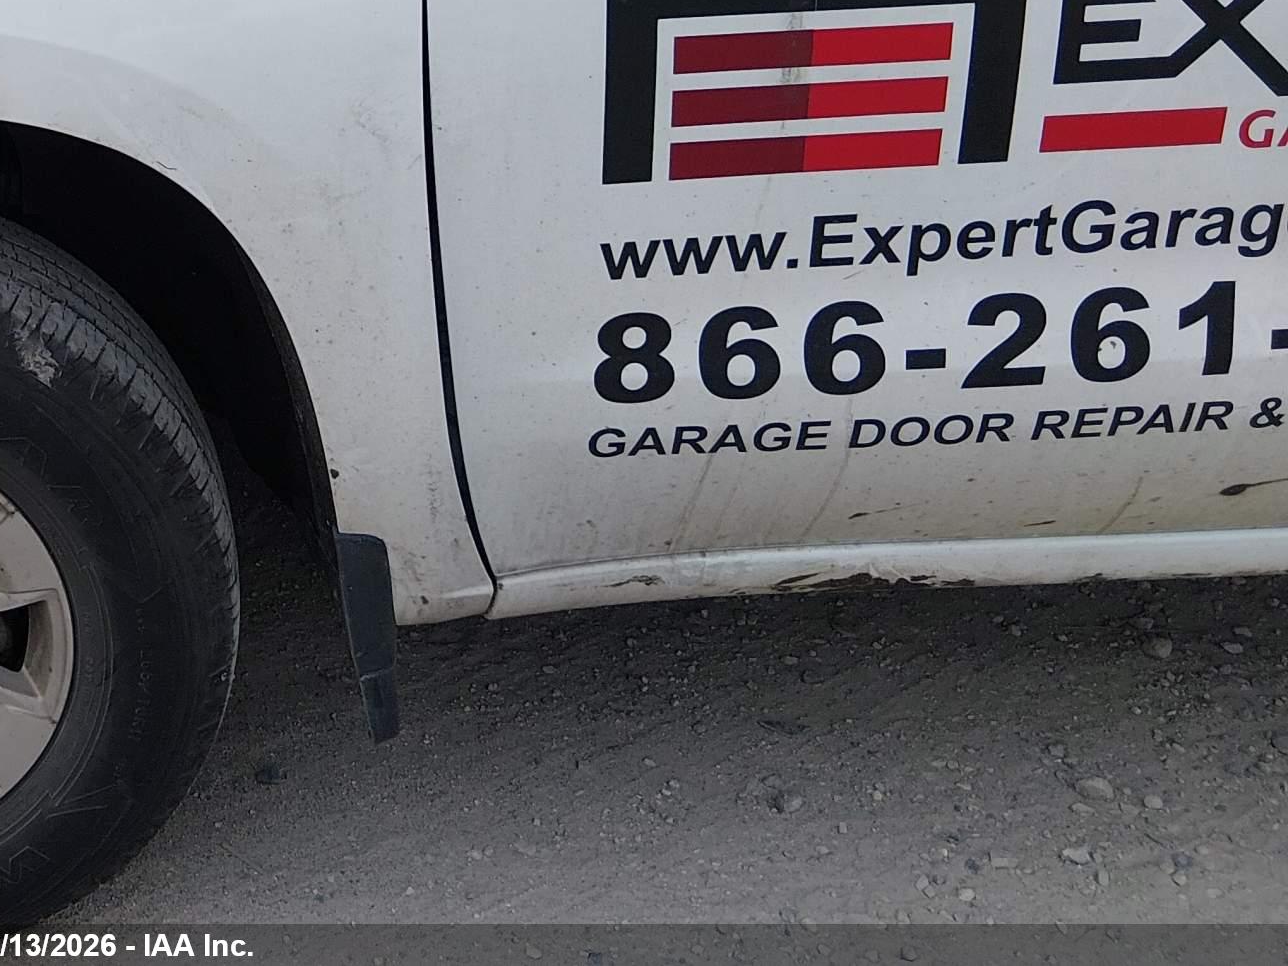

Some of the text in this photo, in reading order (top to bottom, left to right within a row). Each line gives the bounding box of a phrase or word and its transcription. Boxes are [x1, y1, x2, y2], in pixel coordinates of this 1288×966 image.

[1238, 109, 1288, 149] G
[600, 199, 1288, 280] www.ExpertGarag
[588, 397, 1285, 458] GARAGE DOOR REPAIR &
